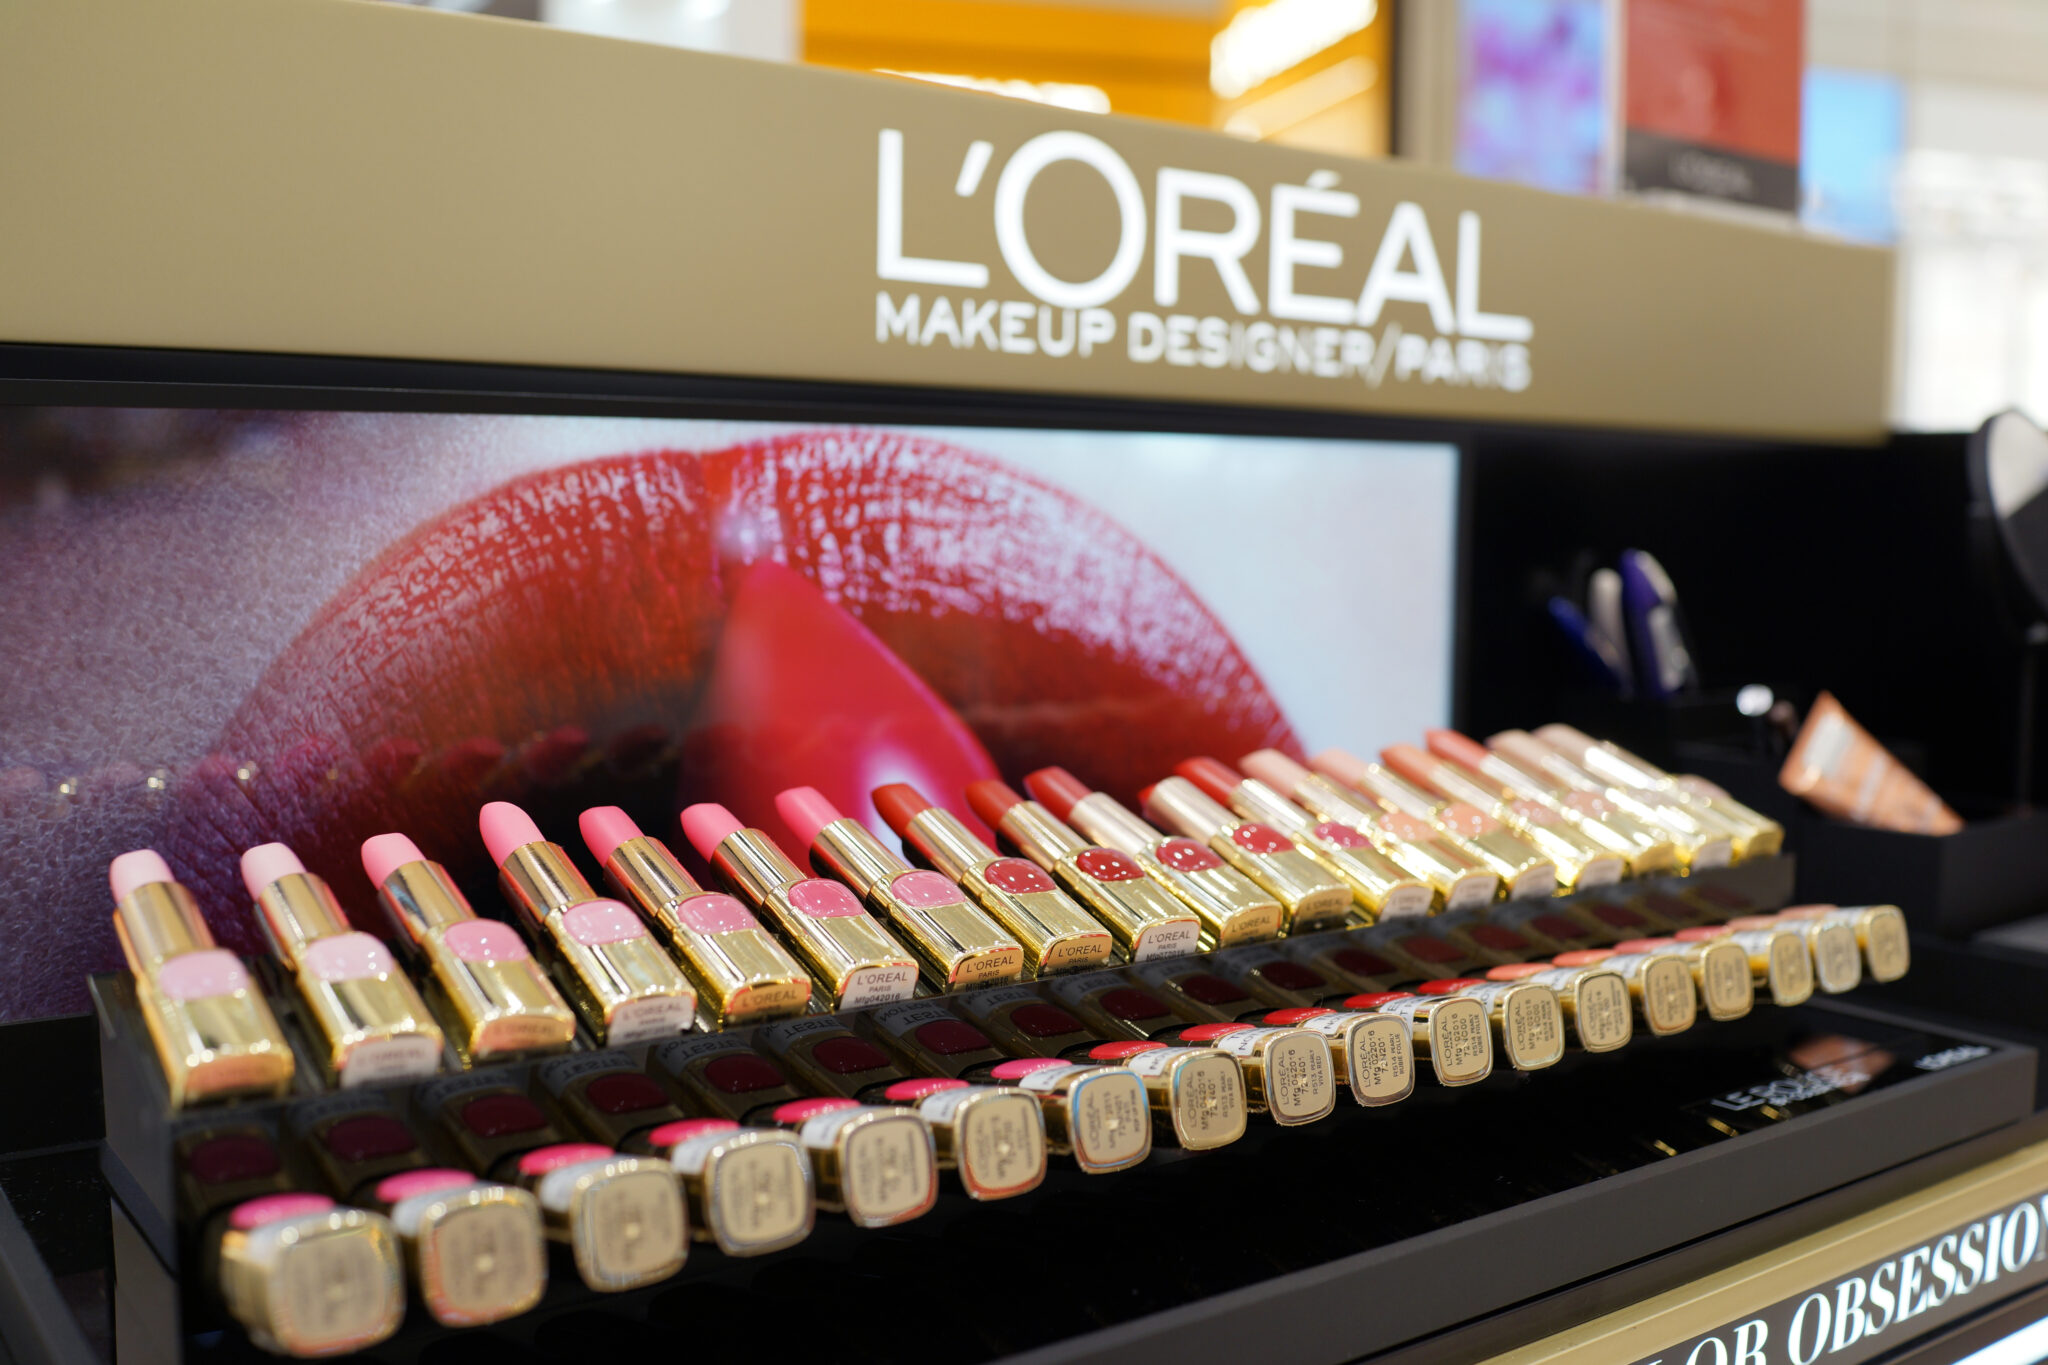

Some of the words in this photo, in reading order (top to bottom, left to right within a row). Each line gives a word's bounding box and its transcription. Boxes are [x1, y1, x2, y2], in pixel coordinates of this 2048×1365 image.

[876, 128, 1534, 344] L'ORÉAL
[876, 290, 1116, 358] MAKEUP
[1293, 1087, 1301, 1107] Mfg
[1373, 1067, 1381, 1086] Mfg
[1787, 1195, 2048, 1365] OBSESSIO
